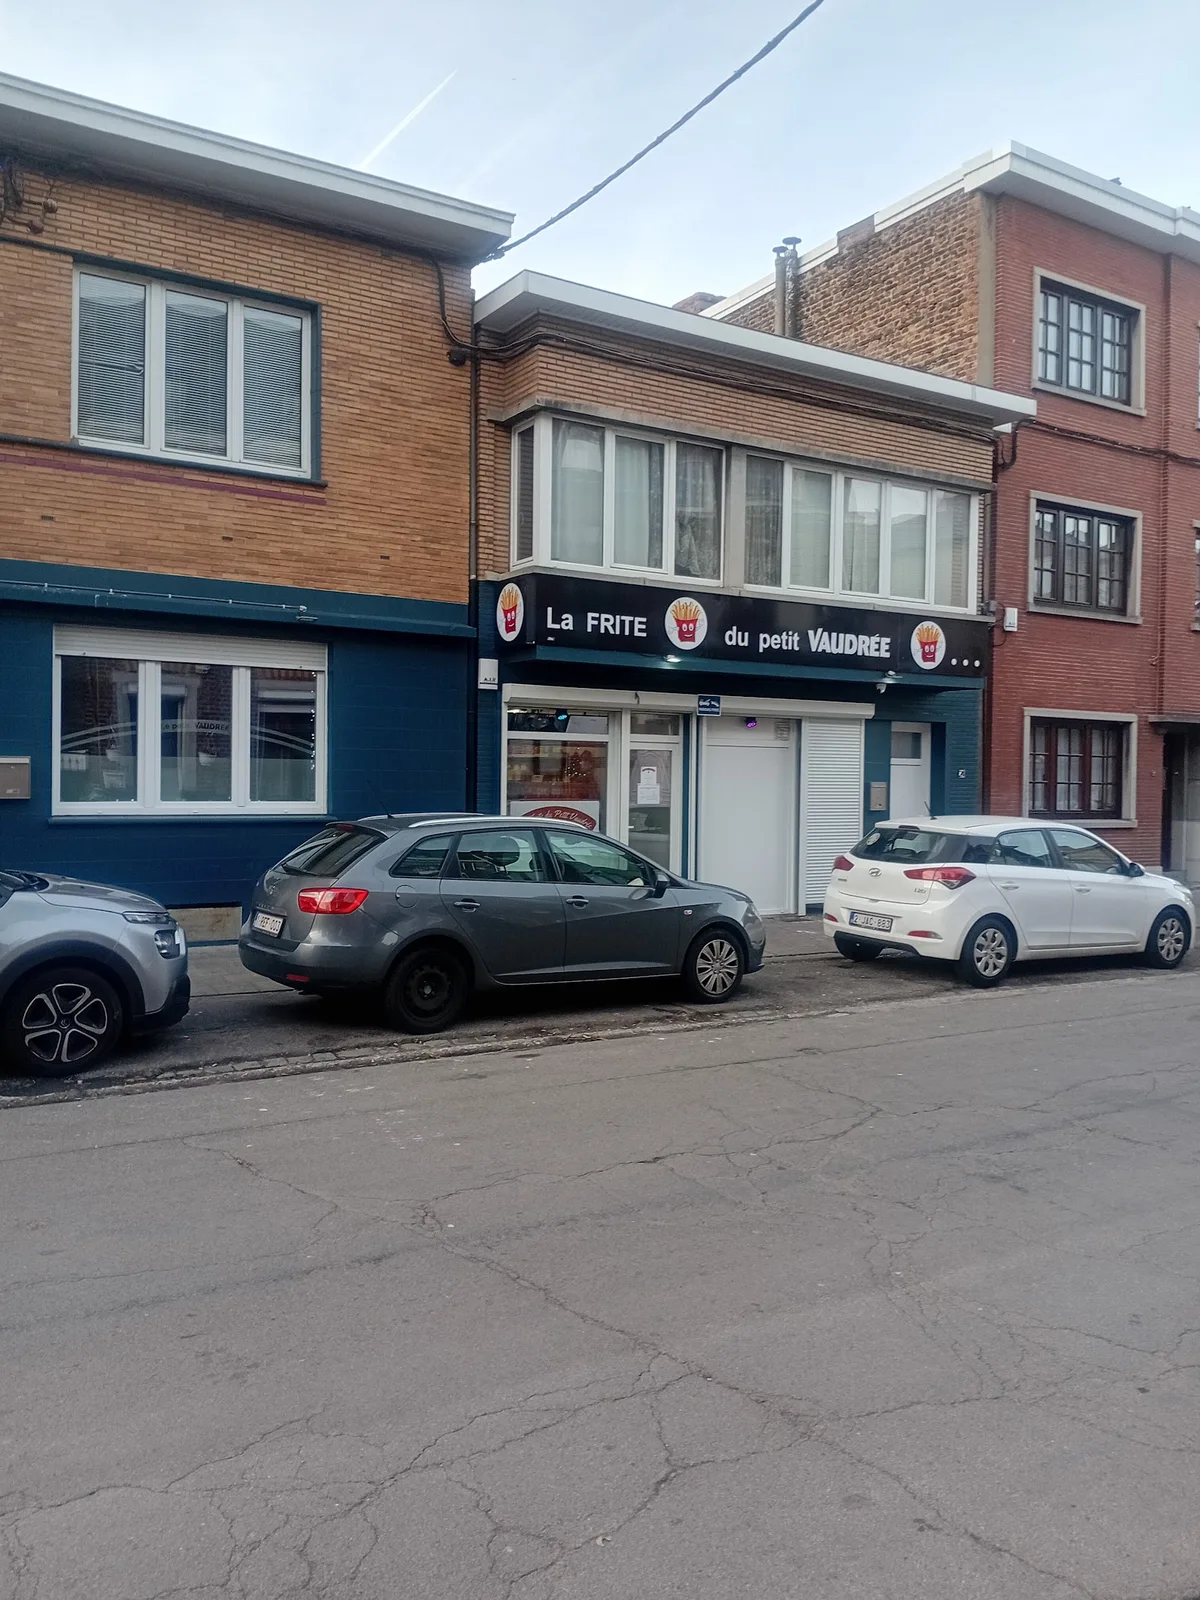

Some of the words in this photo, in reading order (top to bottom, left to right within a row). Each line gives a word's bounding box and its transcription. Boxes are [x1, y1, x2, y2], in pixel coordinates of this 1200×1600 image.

[546, 606, 574, 631] La
[586, 612, 648, 637] FRITE
[724, 626, 749, 647] du
[758, 630, 801, 653] petit
[807, 627, 892, 658] VAUDRÉE
